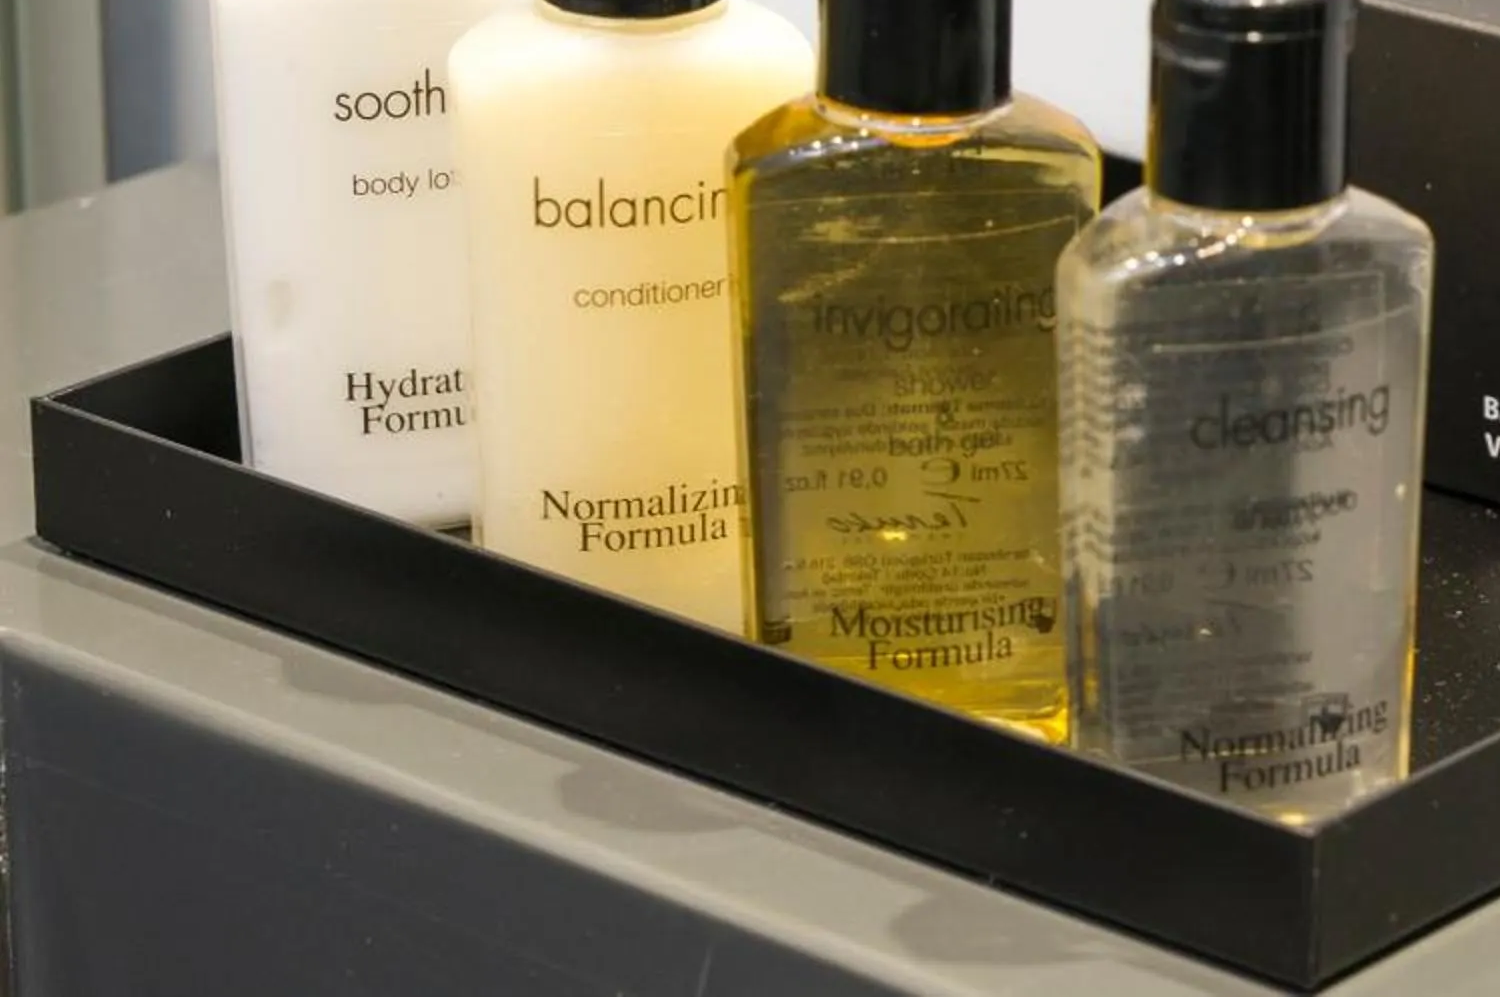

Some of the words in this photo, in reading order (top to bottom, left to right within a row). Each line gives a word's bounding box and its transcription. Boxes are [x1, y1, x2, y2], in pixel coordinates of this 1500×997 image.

[334, 67, 446, 121] sooth
[352, 170, 420, 198] body
[534, 175, 728, 229] balancin
[573, 276, 727, 308] conditioner
[345, 368, 466, 410] Hydrat
[893, 363, 998, 397] shower
[360, 403, 467, 435] Formu
[1188, 383, 1391, 450] cleansing
[888, 426, 954, 457] bath
[959, 426, 1001, 459] gel
[539, 477, 745, 521] Normalizin
[578, 512, 729, 553] Formula
[829, 595, 1046, 640] Moisturising
[867, 631, 1013, 671] Formula
[1218, 740, 1361, 794] Formula
